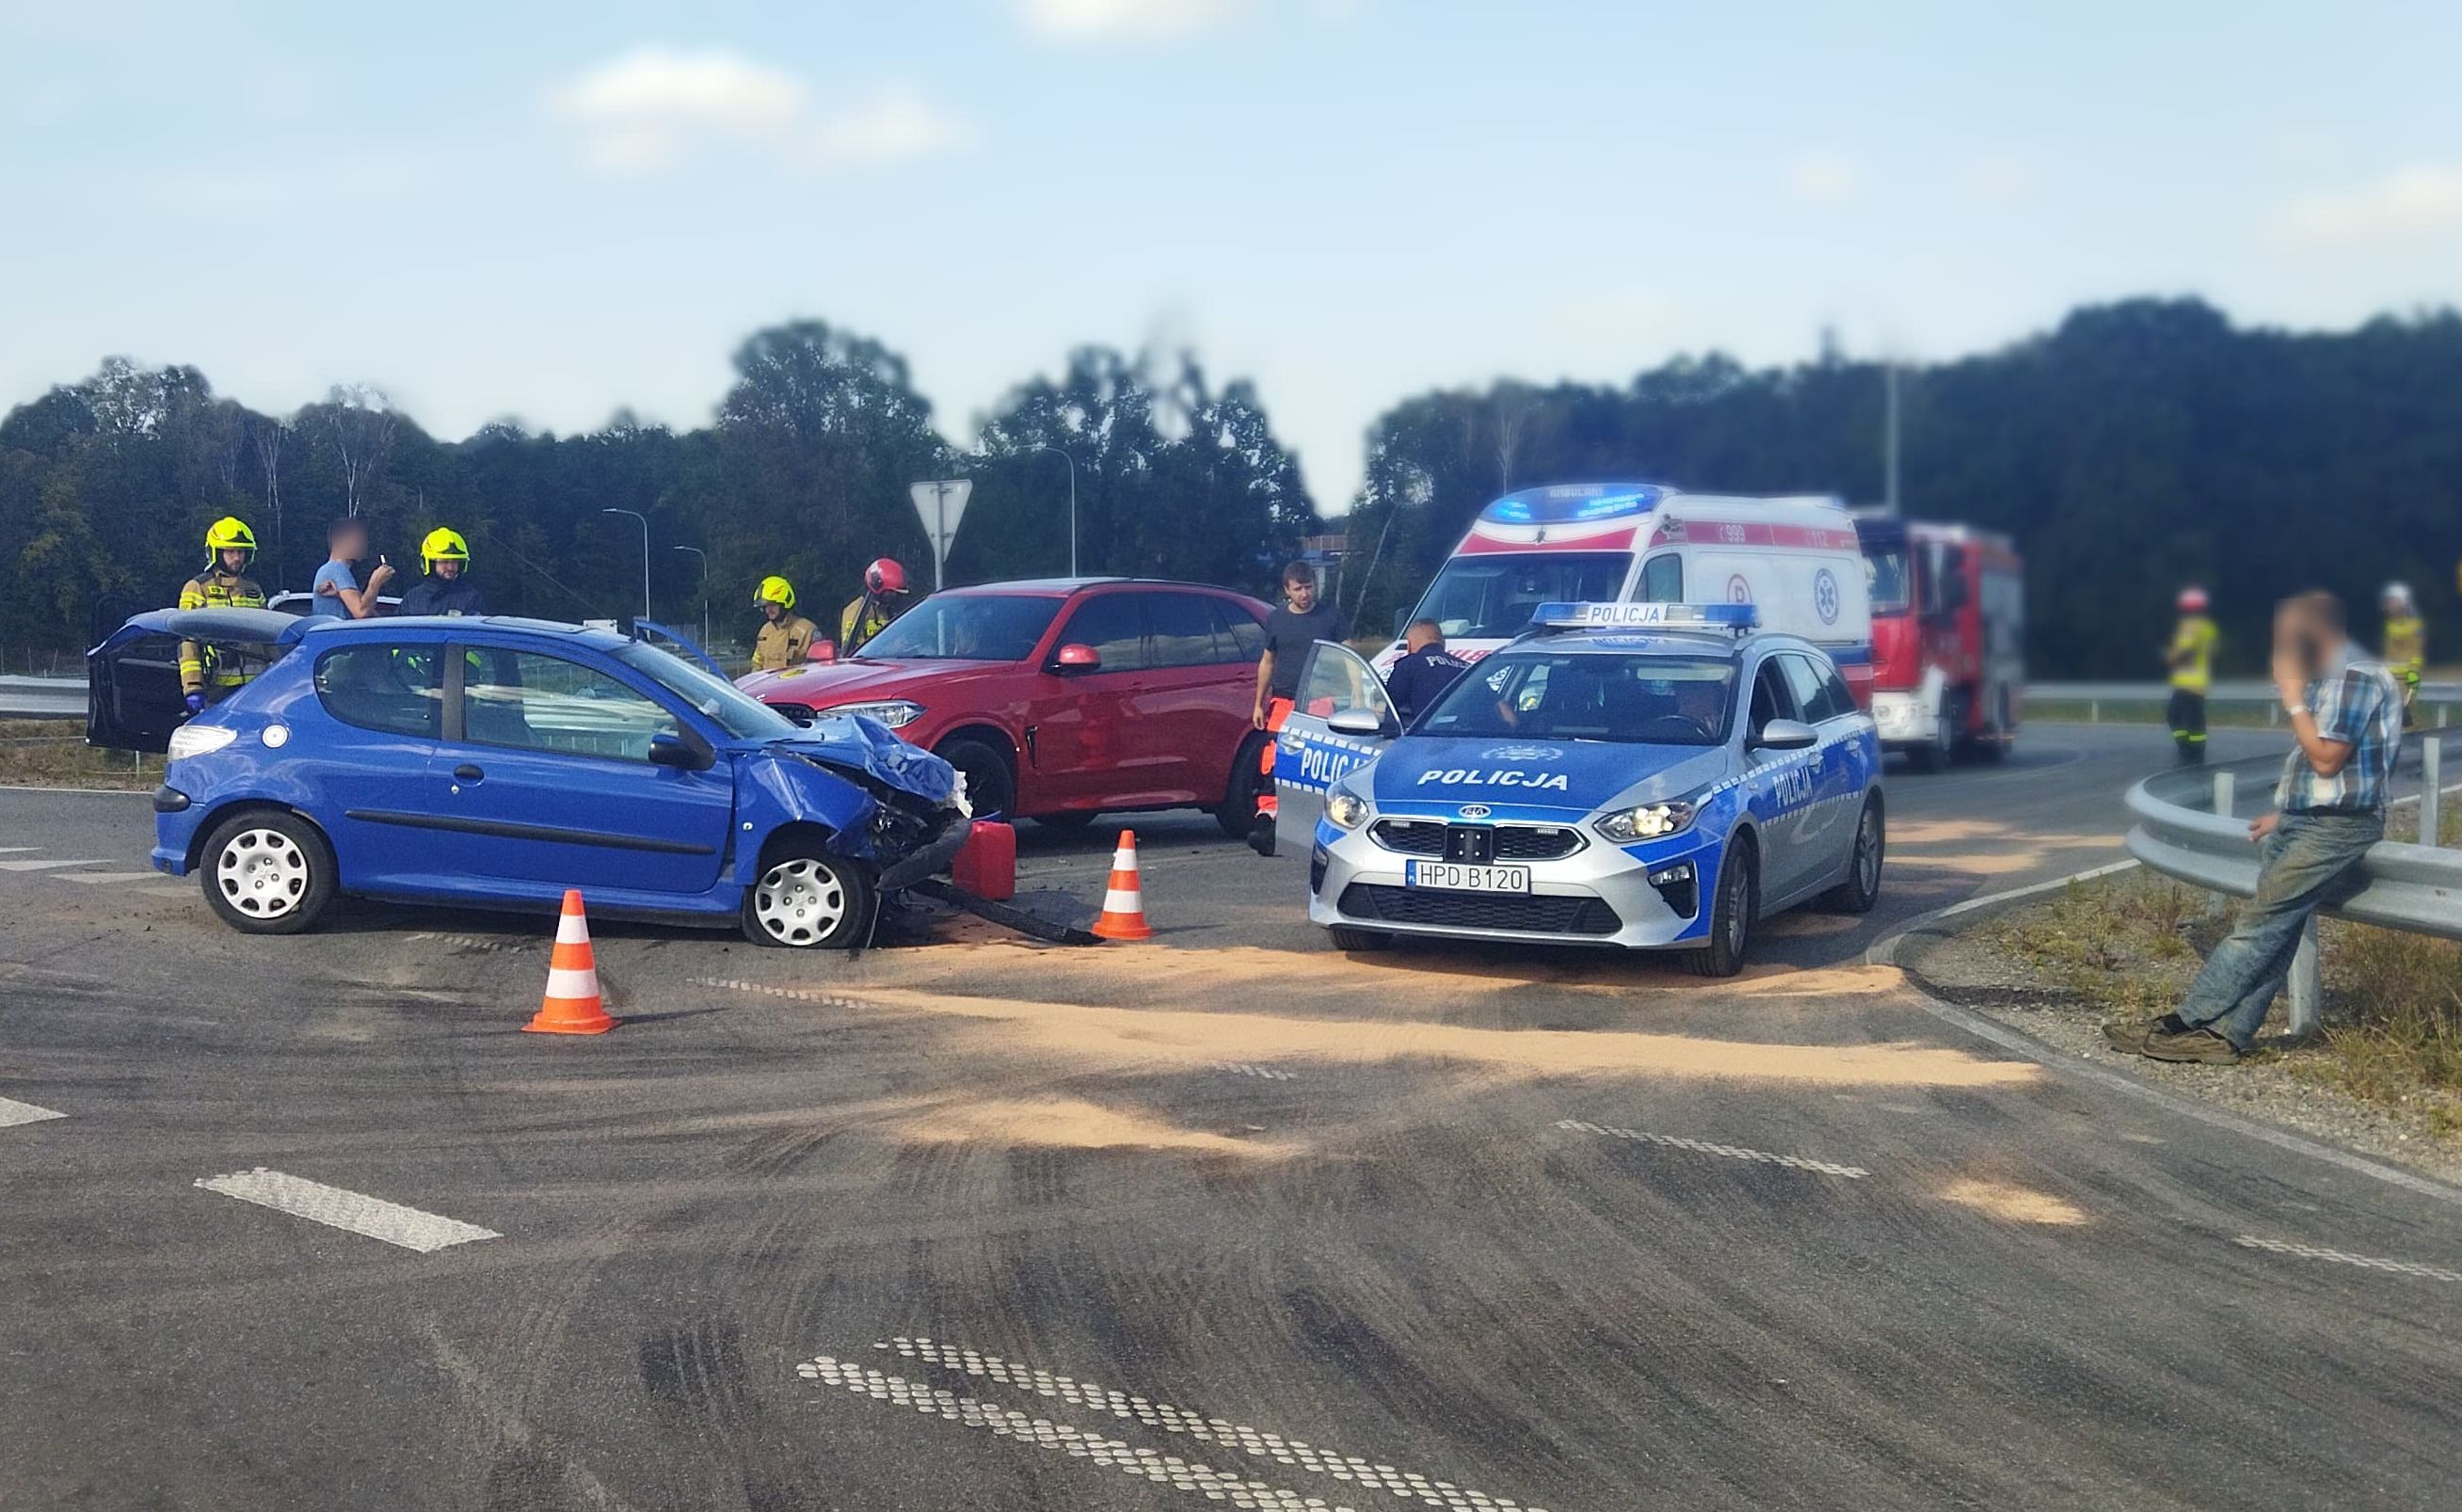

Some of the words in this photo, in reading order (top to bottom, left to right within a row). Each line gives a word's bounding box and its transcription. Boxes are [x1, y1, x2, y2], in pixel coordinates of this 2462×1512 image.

[1725, 524, 1746, 543] 999
[1591, 607, 1659, 623] POLICJA
[1301, 747, 1368, 783] POLIC
[1416, 769, 1568, 791] POLICJA
[1772, 765, 1814, 809] POLICJA
[1420, 864, 1460, 886] HPD
[1469, 867, 1523, 890] B120
